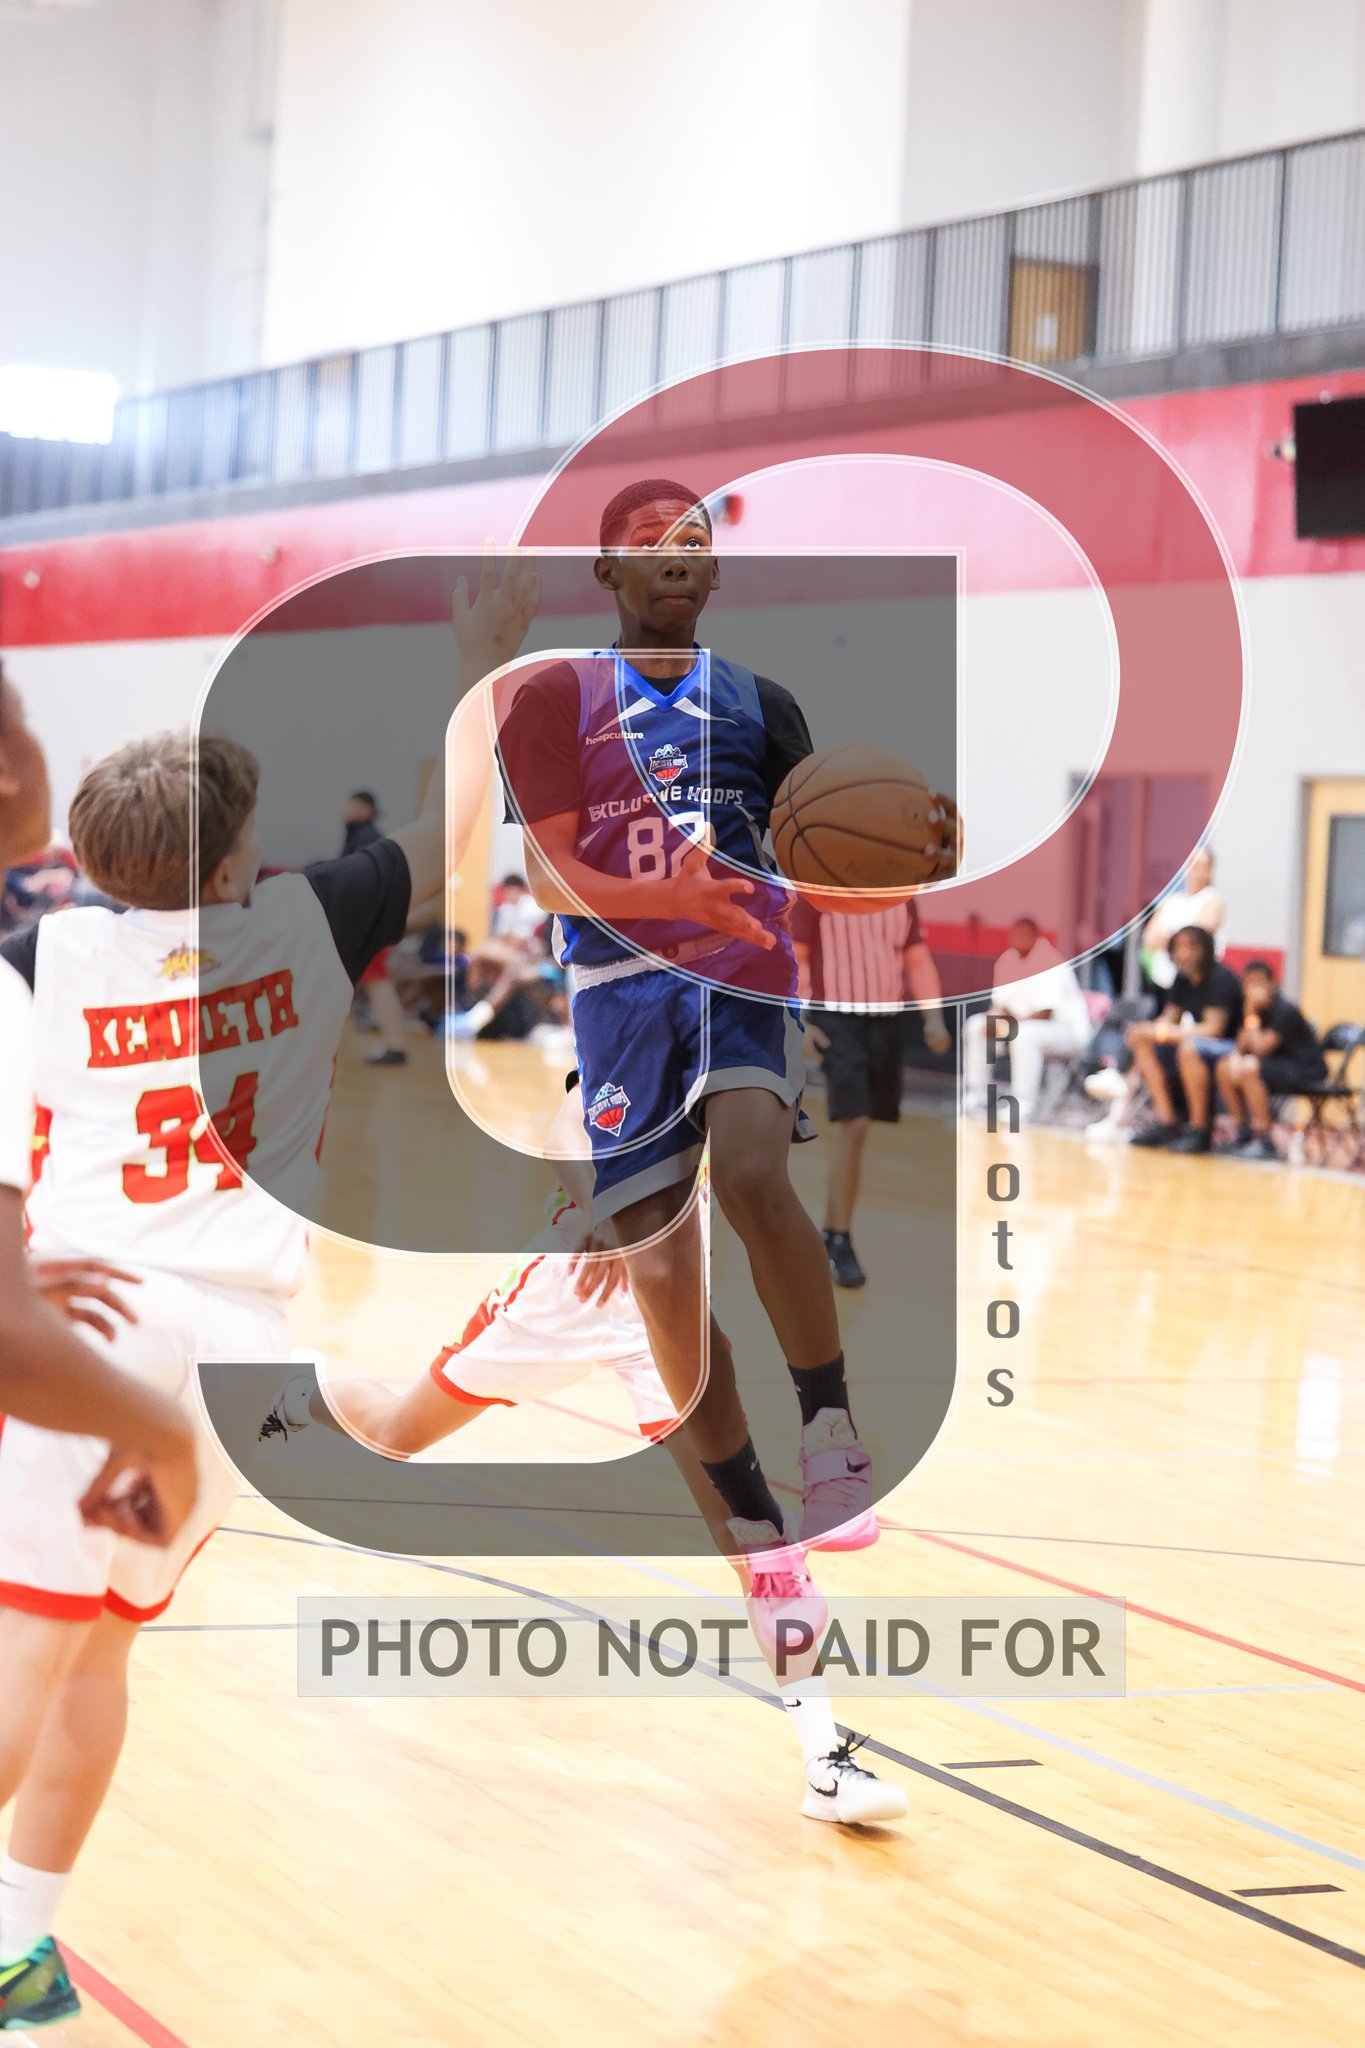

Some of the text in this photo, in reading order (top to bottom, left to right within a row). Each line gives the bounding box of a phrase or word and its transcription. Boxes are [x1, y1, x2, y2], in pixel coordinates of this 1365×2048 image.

[585, 730, 644, 746] hoopculture
[687, 785, 744, 808] HOOPS
[83, 968, 299, 1069] KENNETH
[122, 1071, 259, 1204] 34
